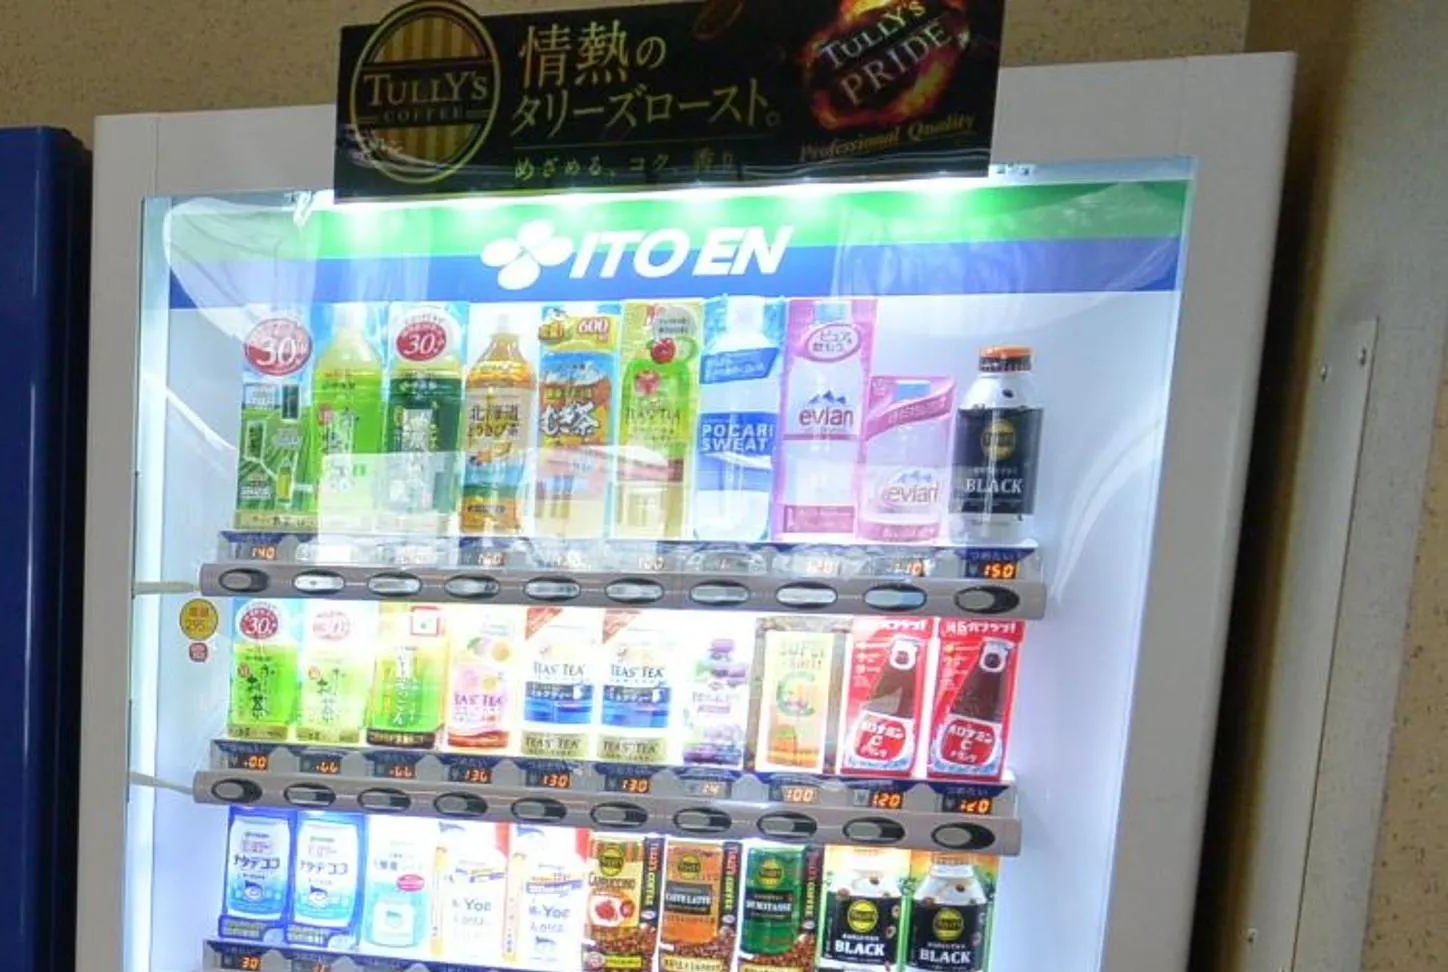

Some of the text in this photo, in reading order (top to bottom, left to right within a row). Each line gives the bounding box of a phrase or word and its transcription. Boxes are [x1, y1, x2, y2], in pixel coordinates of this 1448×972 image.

[519, 20, 666, 91] 情熱の
[840, 20, 952, 105] PRIDE
[382, 107, 465, 123] COFFEE
[799, 406, 853, 426] evian
[701, 422, 774, 438] POCARI
[701, 437, 767, 452] SWEAT
[888, 482, 939, 503] evian
[965, 478, 1024, 494] BLACK
[984, 561, 1014, 579] 150
[543, 773, 569, 787] 130
[622, 778, 648, 792] 130
[872, 792, 901, 807] 120
[834, 939, 885, 956] BLACK
[919, 947, 971, 964] BLACK
